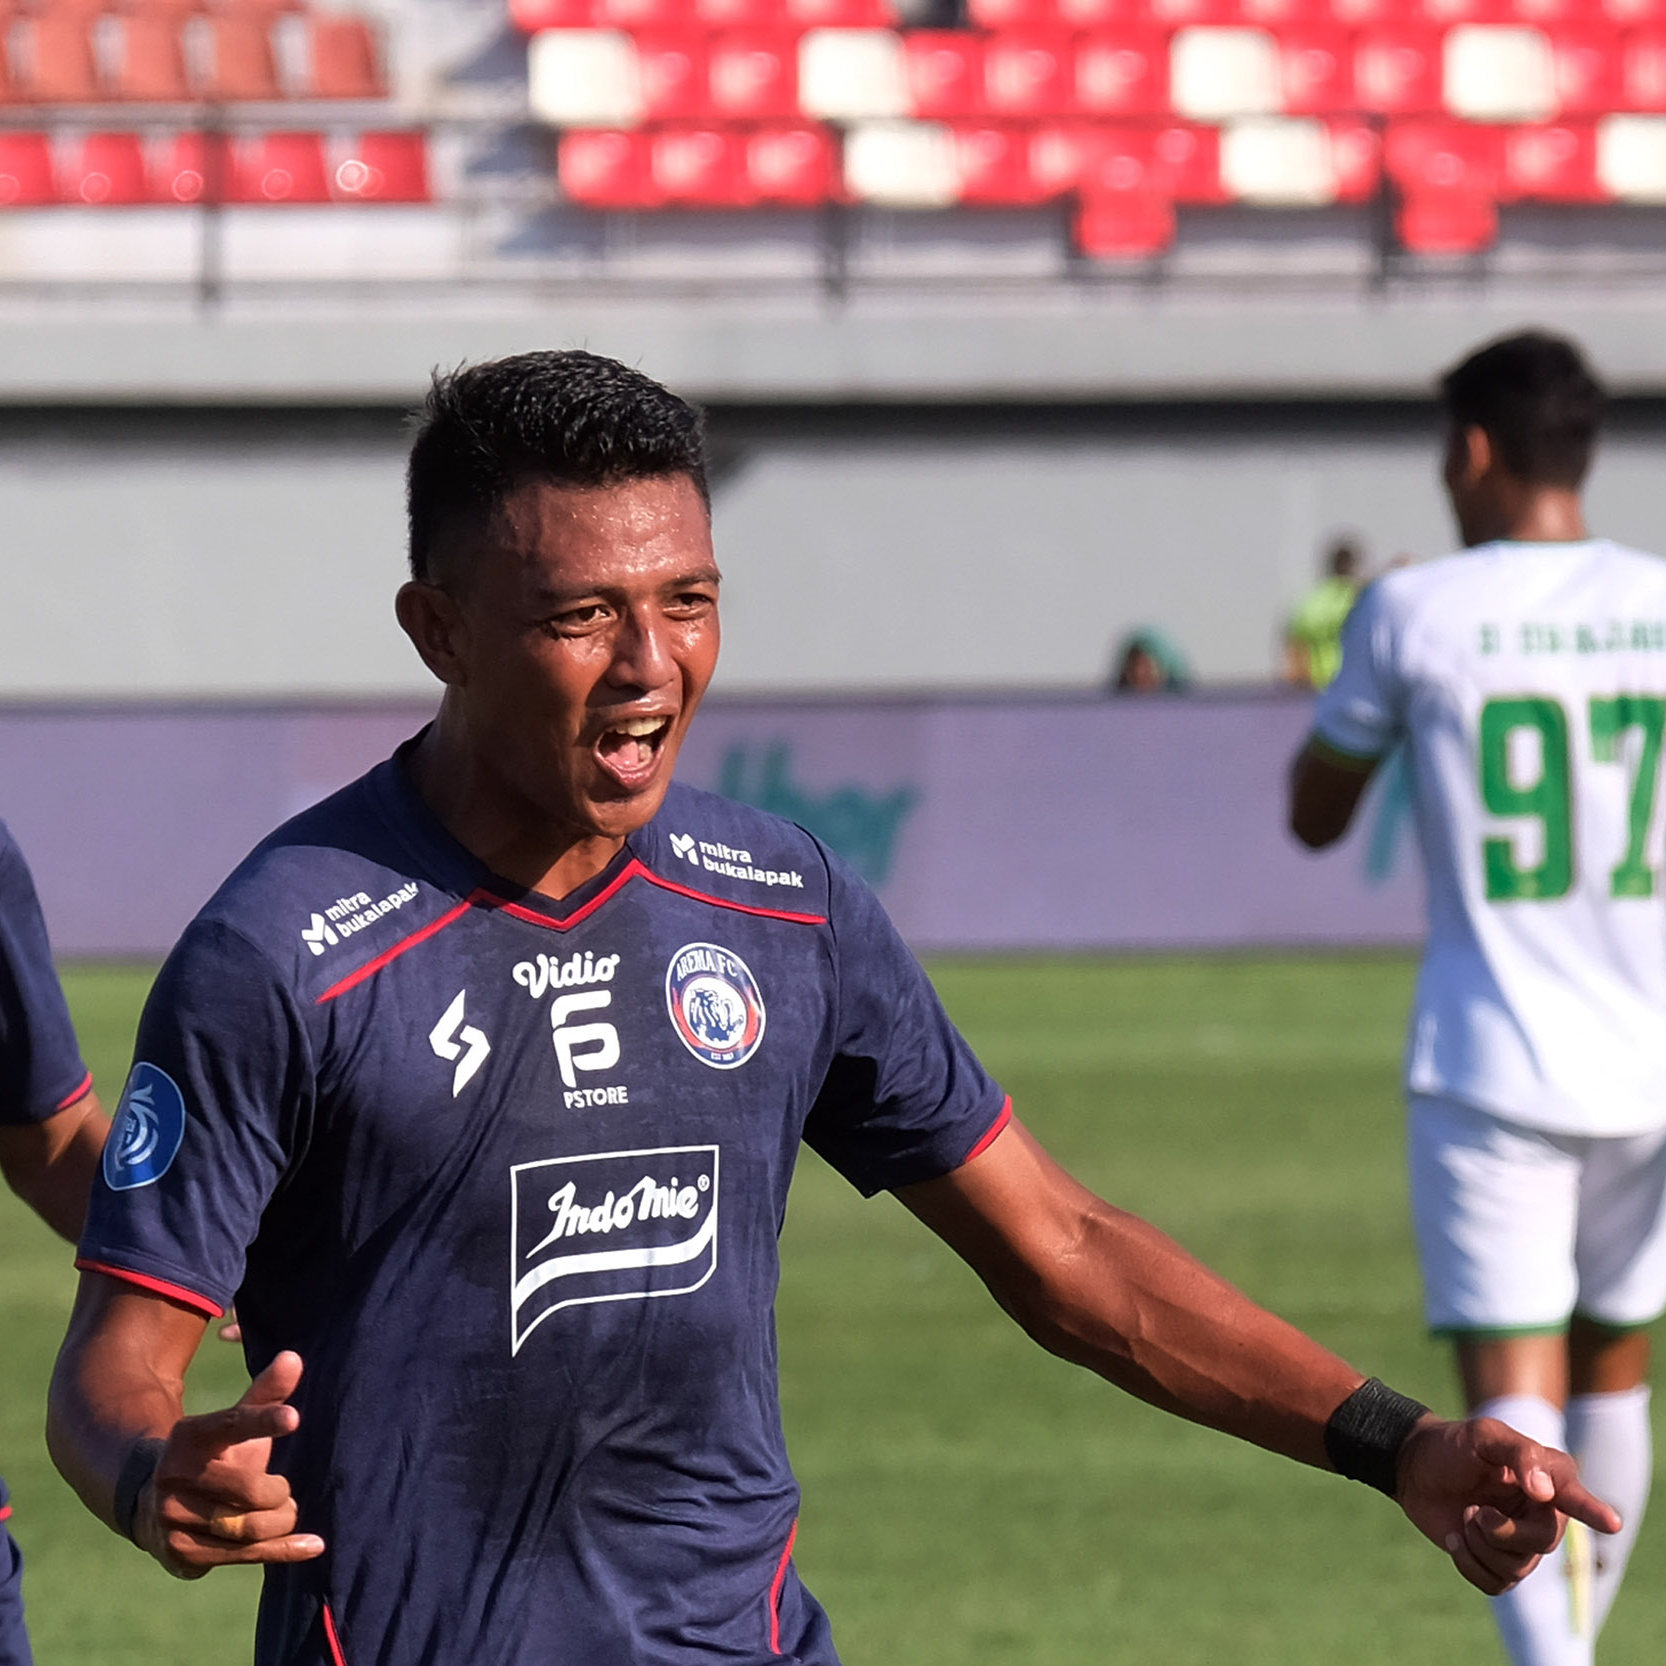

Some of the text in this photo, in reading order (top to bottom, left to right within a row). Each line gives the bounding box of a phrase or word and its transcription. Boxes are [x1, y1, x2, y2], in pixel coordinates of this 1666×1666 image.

[698, 841, 752, 863] mitra
[703, 855, 804, 888] bukalapak
[324, 892, 372, 921] mitra
[335, 882, 419, 937] bukalapak
[513, 951, 620, 999] Vidio
[676, 949, 738, 981] AREMA FC
[564, 1085, 629, 1109] PSTORE
